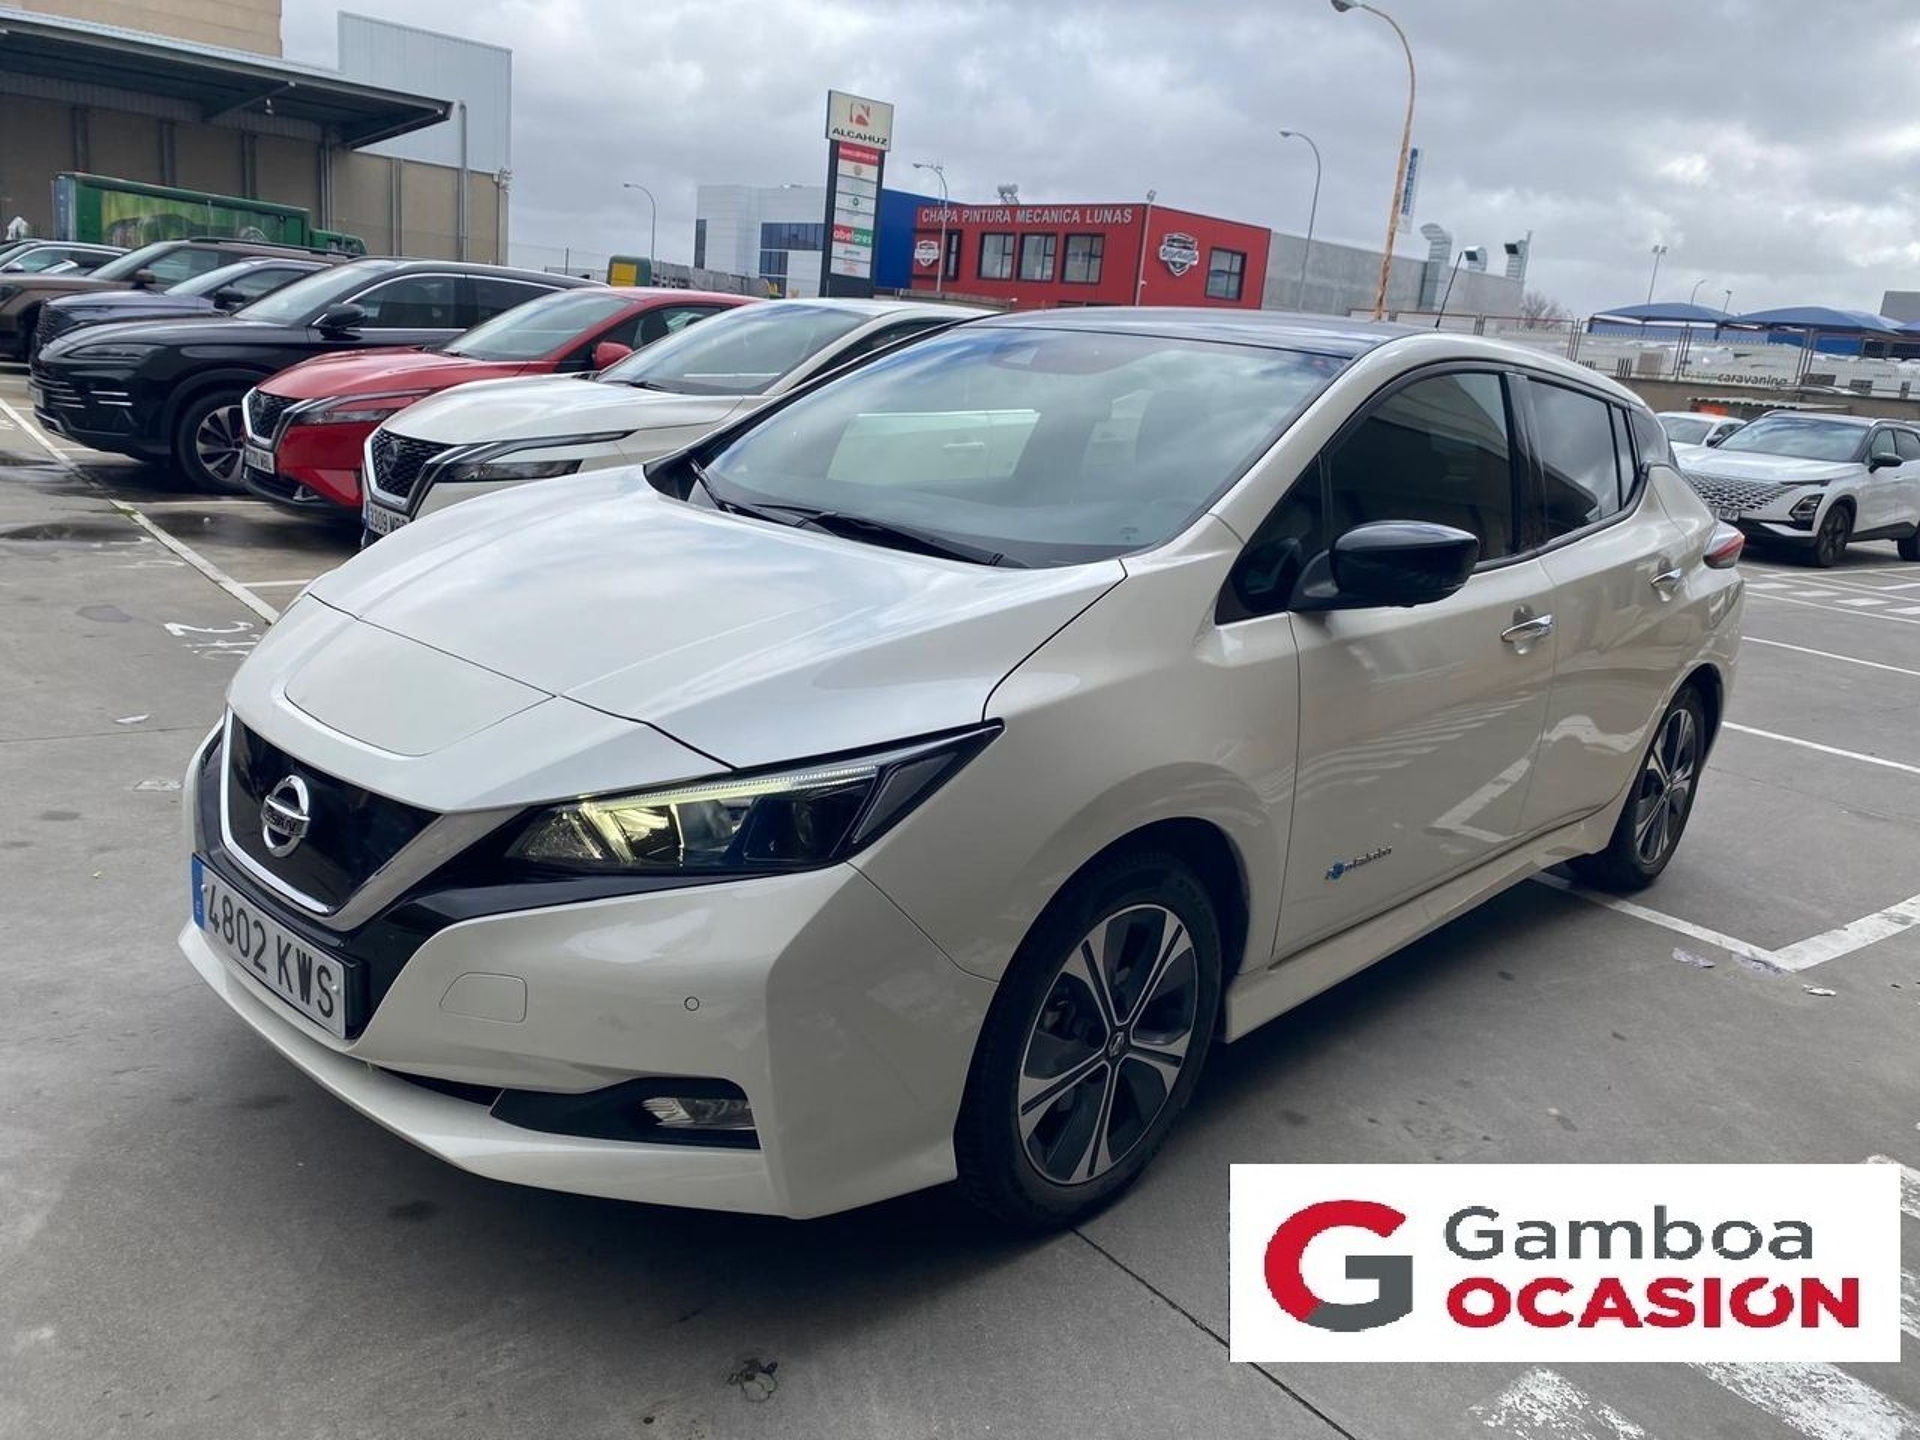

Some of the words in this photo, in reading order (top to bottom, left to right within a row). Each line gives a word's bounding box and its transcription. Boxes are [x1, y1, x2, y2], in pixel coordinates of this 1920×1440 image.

[832, 127, 888, 145] ALCAHUZ
[921, 208, 958, 223] CHAPA
[963, 208, 1012, 223] PINTURA
[1016, 208, 1081, 224] MECANICA
[1085, 208, 1133, 224] LUNAS
[208, 884, 267, 974] 4802
[275, 934, 334, 1019] KWS
